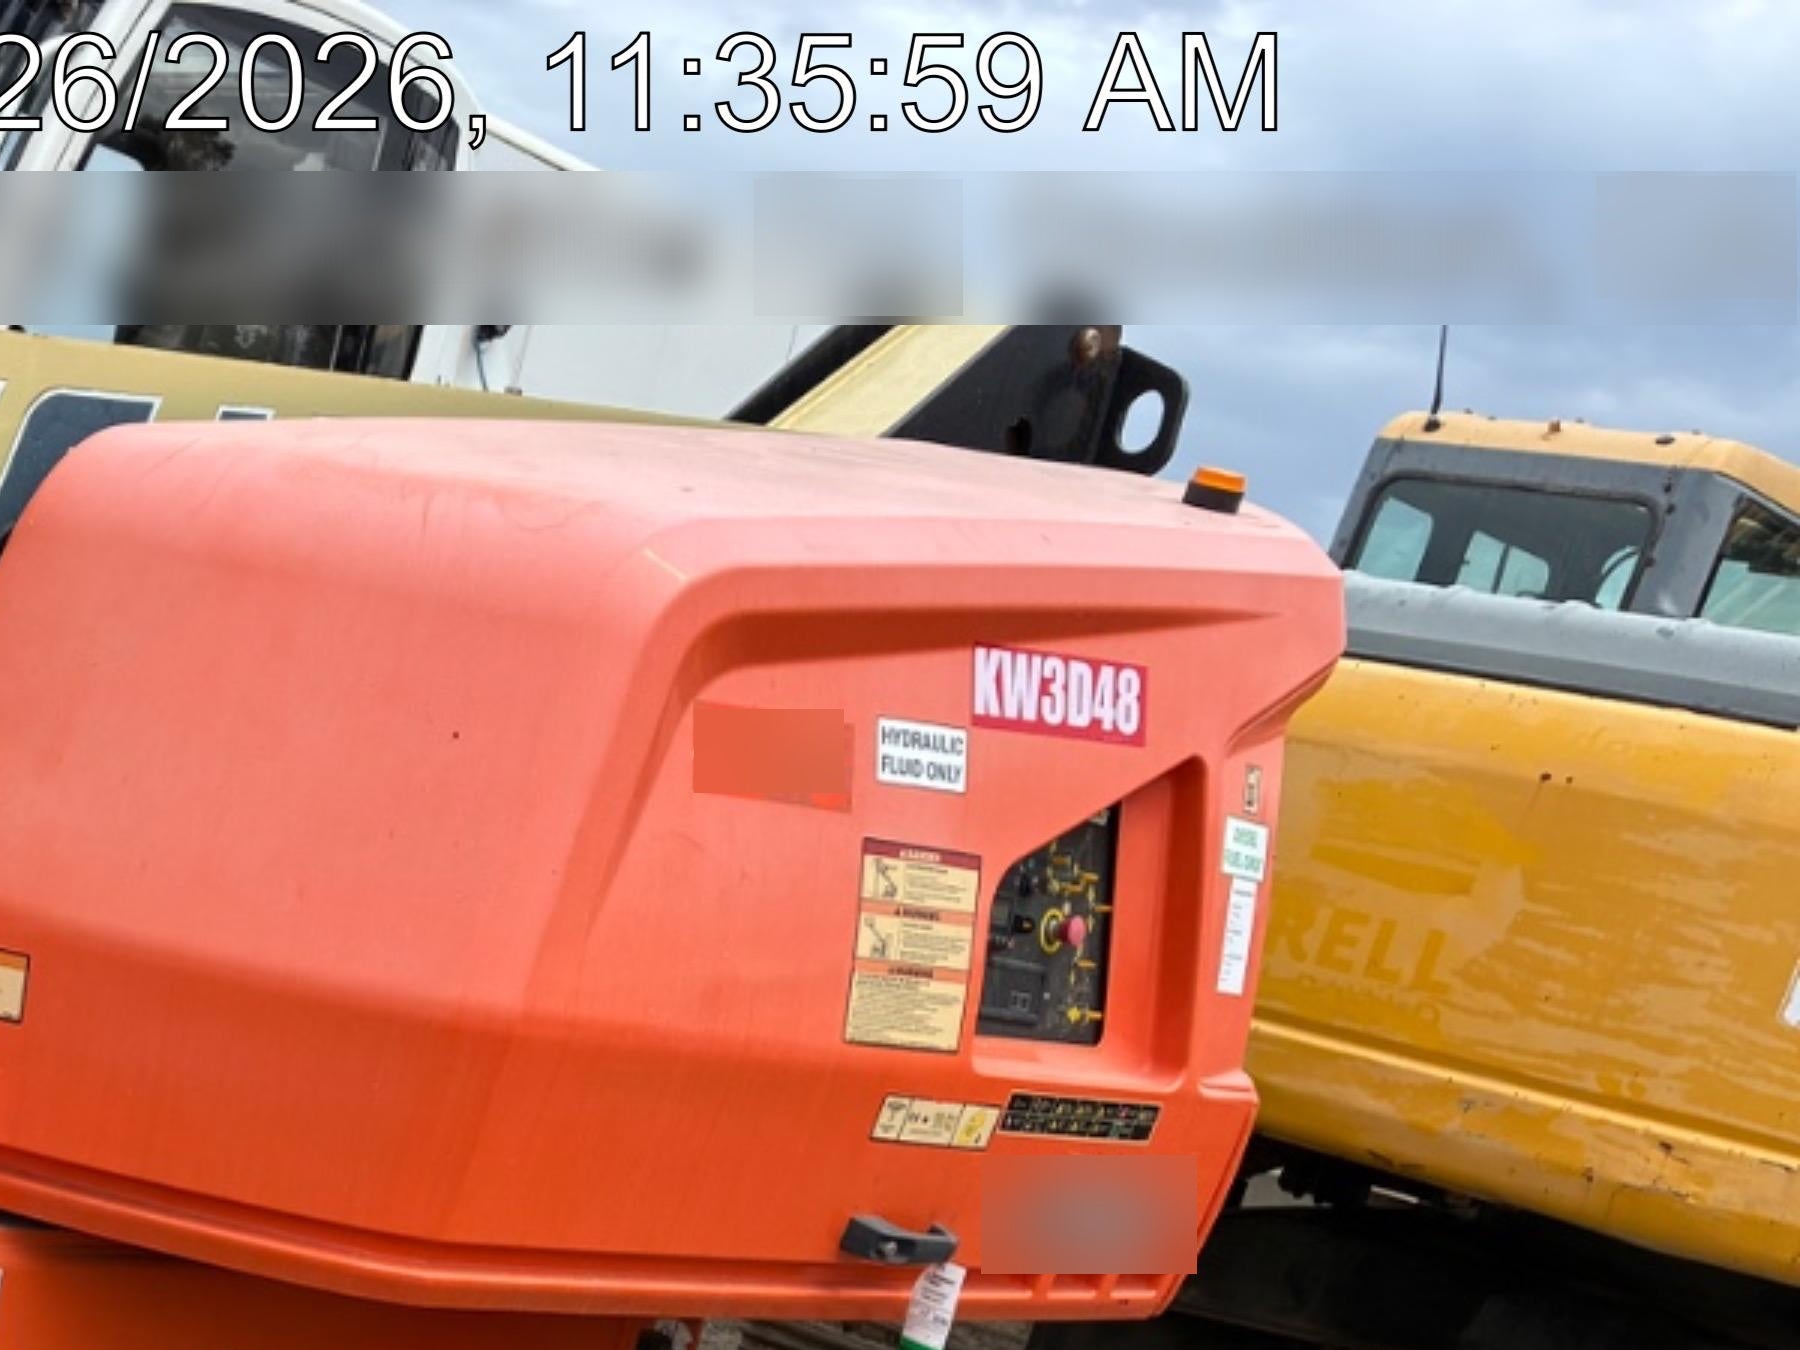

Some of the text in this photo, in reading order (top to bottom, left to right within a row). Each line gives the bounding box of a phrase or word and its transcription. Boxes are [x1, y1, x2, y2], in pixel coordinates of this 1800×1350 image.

[973, 646, 1141, 737] KW3D48
[881, 725, 964, 756] HYDRAULIC
[881, 755, 963, 784] FLUID ONLY
